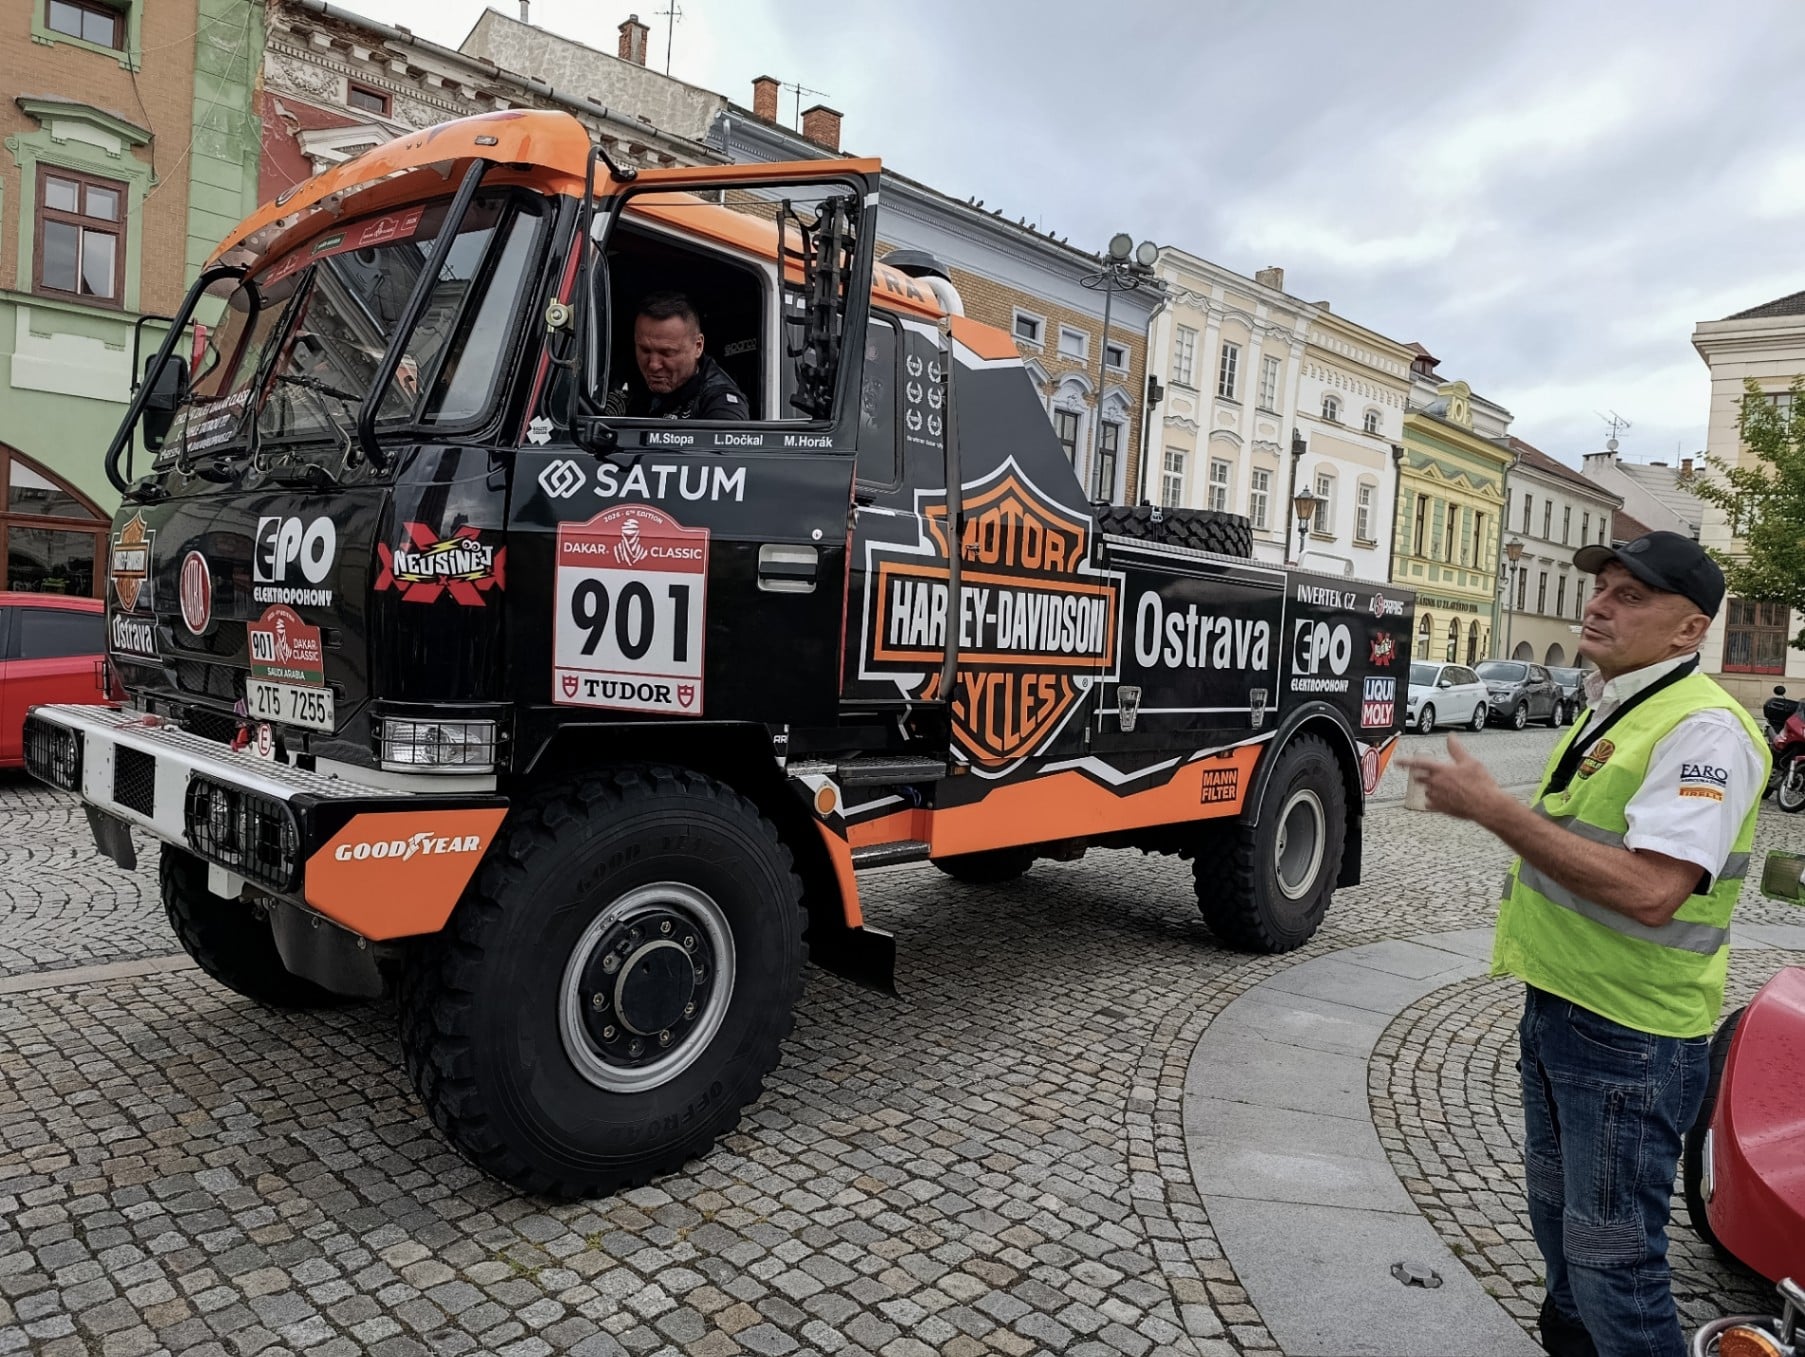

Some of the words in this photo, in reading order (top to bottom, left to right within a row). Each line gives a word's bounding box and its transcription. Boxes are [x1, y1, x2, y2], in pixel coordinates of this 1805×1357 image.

[649, 433, 694, 446] M.Stopa
[714, 434, 763, 446] L.Dočkal
[784, 435, 833, 448] M.Horák
[593, 463, 747, 502] SATUM
[636, 510, 664, 524] EDITION
[960, 496, 1066, 573] MOTOR
[253, 516, 337, 584] EPO
[563, 542, 606, 554] DAKAR
[650, 546, 703, 560] CLASSIC
[253, 586, 332, 607] ELEKTROPOHONY
[1297, 584, 1342, 608] INVERTEK
[1344, 593, 1356, 610] CZ
[571, 578, 690, 662] 901
[889, 580, 1106, 653] HAREY-DAVIDSON
[113, 614, 153, 653] Ostrava
[1135, 590, 1270, 671] Ostrava
[253, 632, 273, 659] 901
[293, 638, 316, 649] DAKAR
[1291, 618, 1352, 676] EPO
[293, 651, 319, 662] CLASSIC
[284, 669, 305, 680] ARABIA
[584, 679, 672, 704] TUDOR
[1364, 679, 1394, 702] LIQUI
[257, 685, 281, 715] 2T5
[290, 690, 326, 723] 7255
[1362, 703, 1393, 725] MOLY
[261, 728, 268, 751] E
[1203, 770, 1237, 786] MANN
[1680, 764, 1728, 784] FARO
[1202, 785, 1236, 802] FILTER
[335, 832, 480, 861] GOODYEAR
